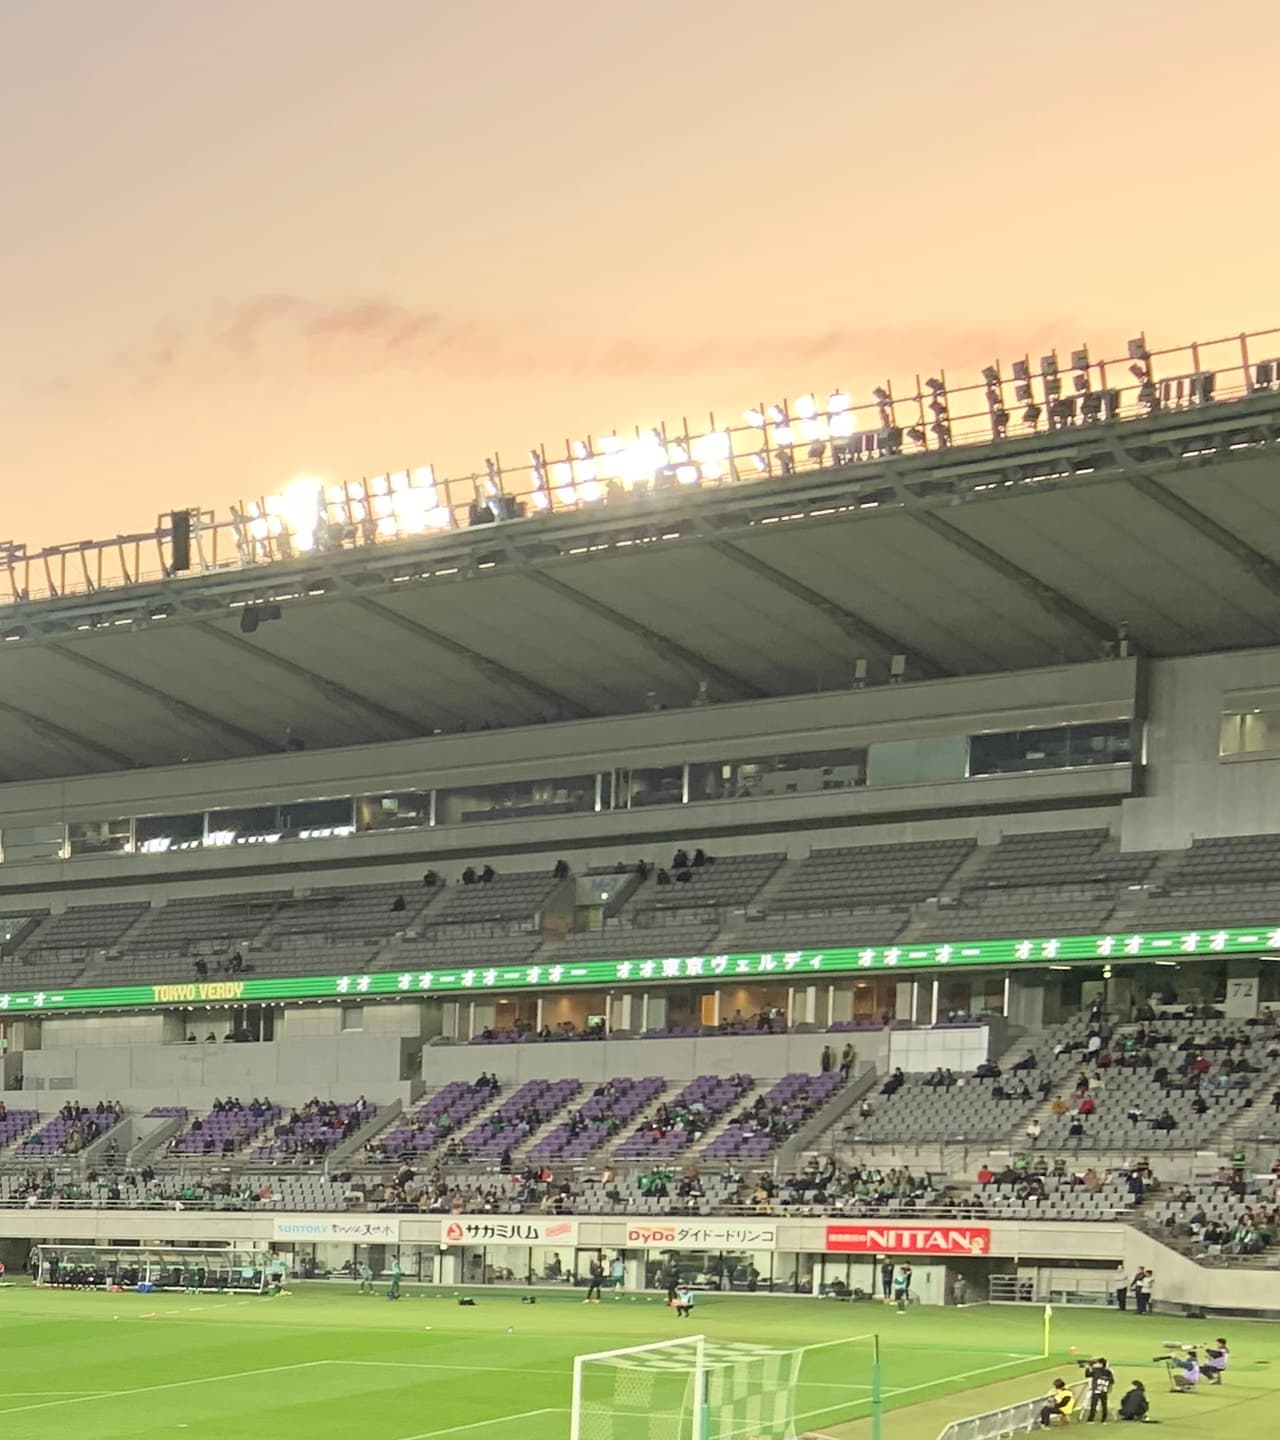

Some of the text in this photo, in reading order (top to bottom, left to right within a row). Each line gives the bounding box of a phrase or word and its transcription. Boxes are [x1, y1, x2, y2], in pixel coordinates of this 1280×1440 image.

[153, 984, 196, 1002] TOKYO
[199, 982, 244, 1000] VERDY
[1232, 982, 1253, 998] 72
[466, 1224, 539, 1240] サカミハム
[628, 1228, 774, 1244] DyDo ダイドードリンコ
[866, 1229, 972, 1250] NITTAN
